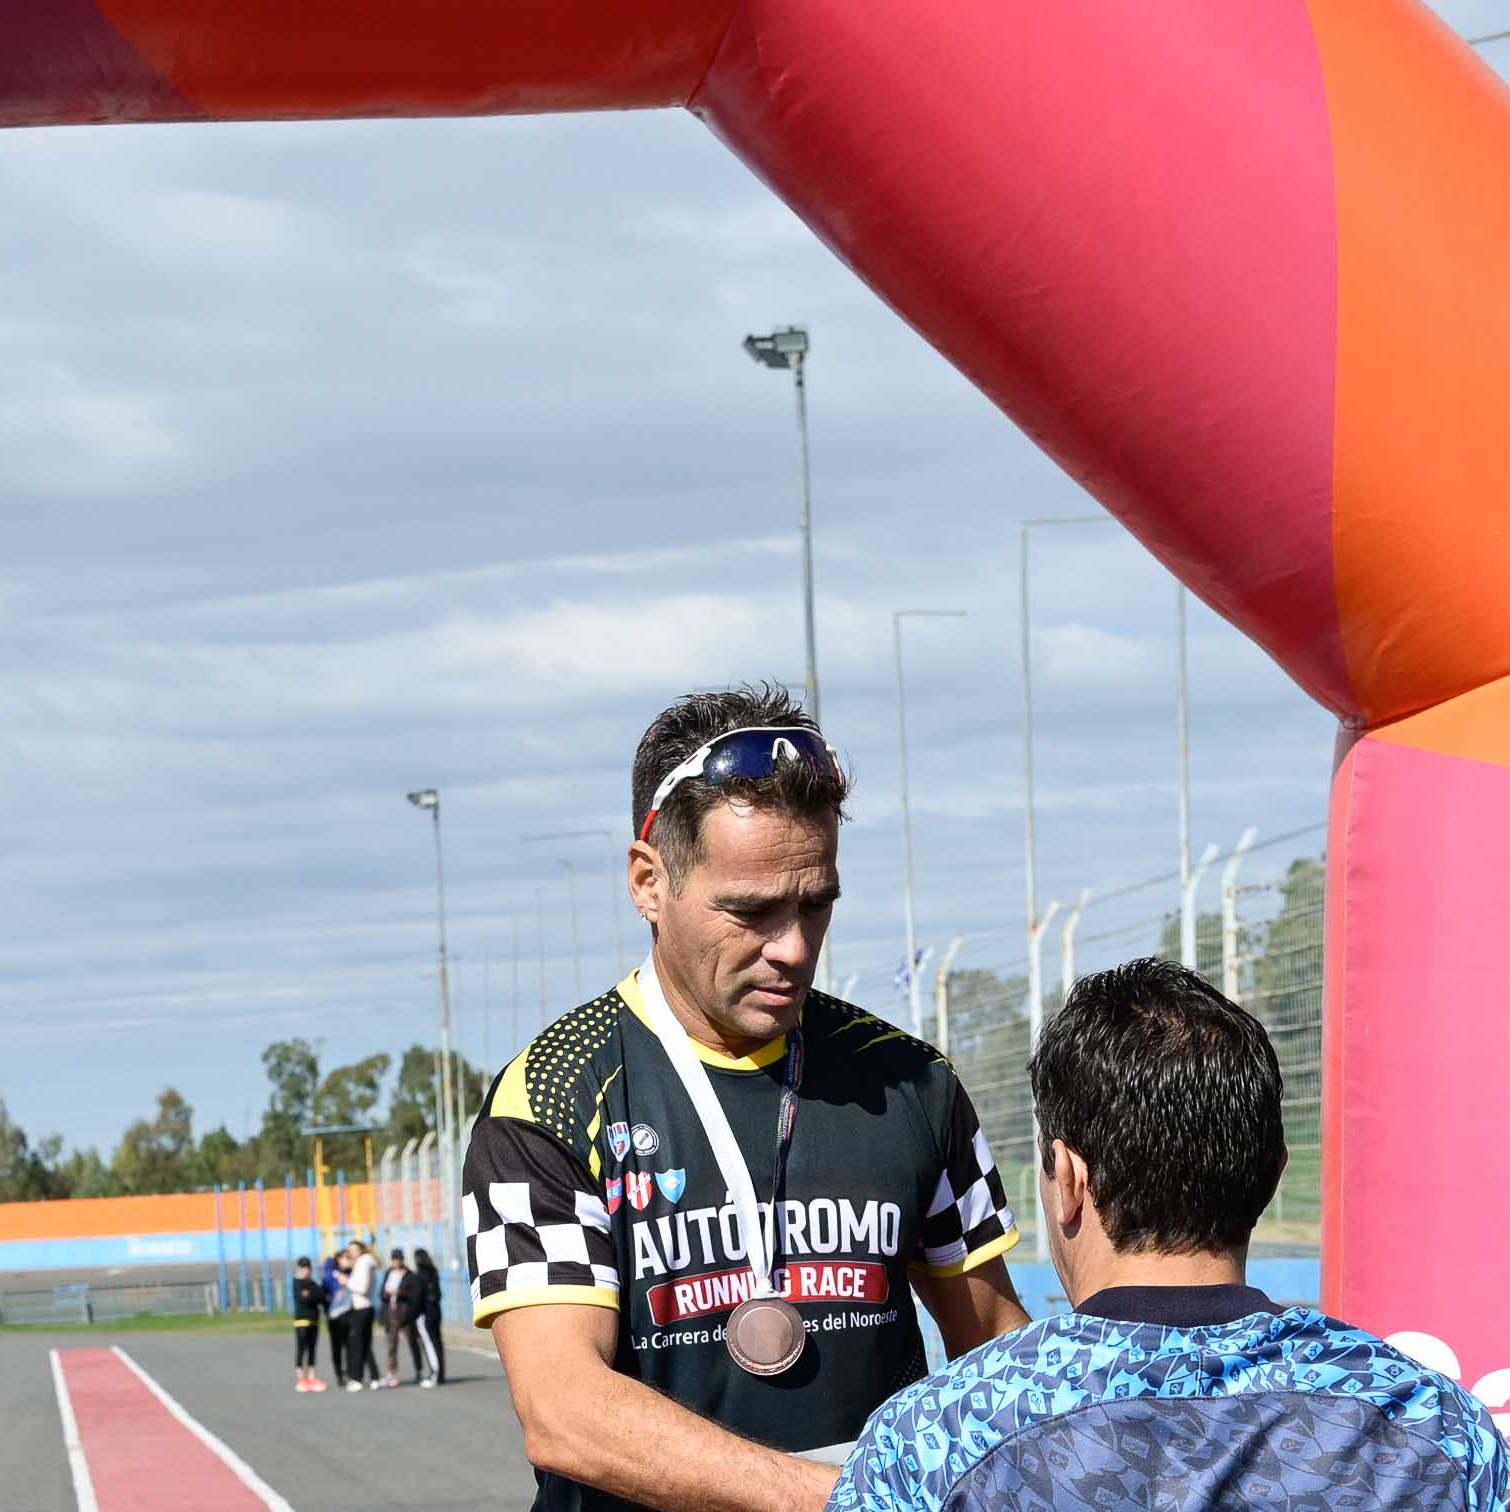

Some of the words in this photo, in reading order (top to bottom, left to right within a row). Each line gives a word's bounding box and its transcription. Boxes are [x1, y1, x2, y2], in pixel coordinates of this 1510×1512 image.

[799, 1266, 867, 1298] RACE
[631, 1334, 648, 1350] La
[651, 1330, 709, 1350] Carrera
[822, 1312, 847, 1331] del
[850, 1308, 898, 1328] Noroeste
